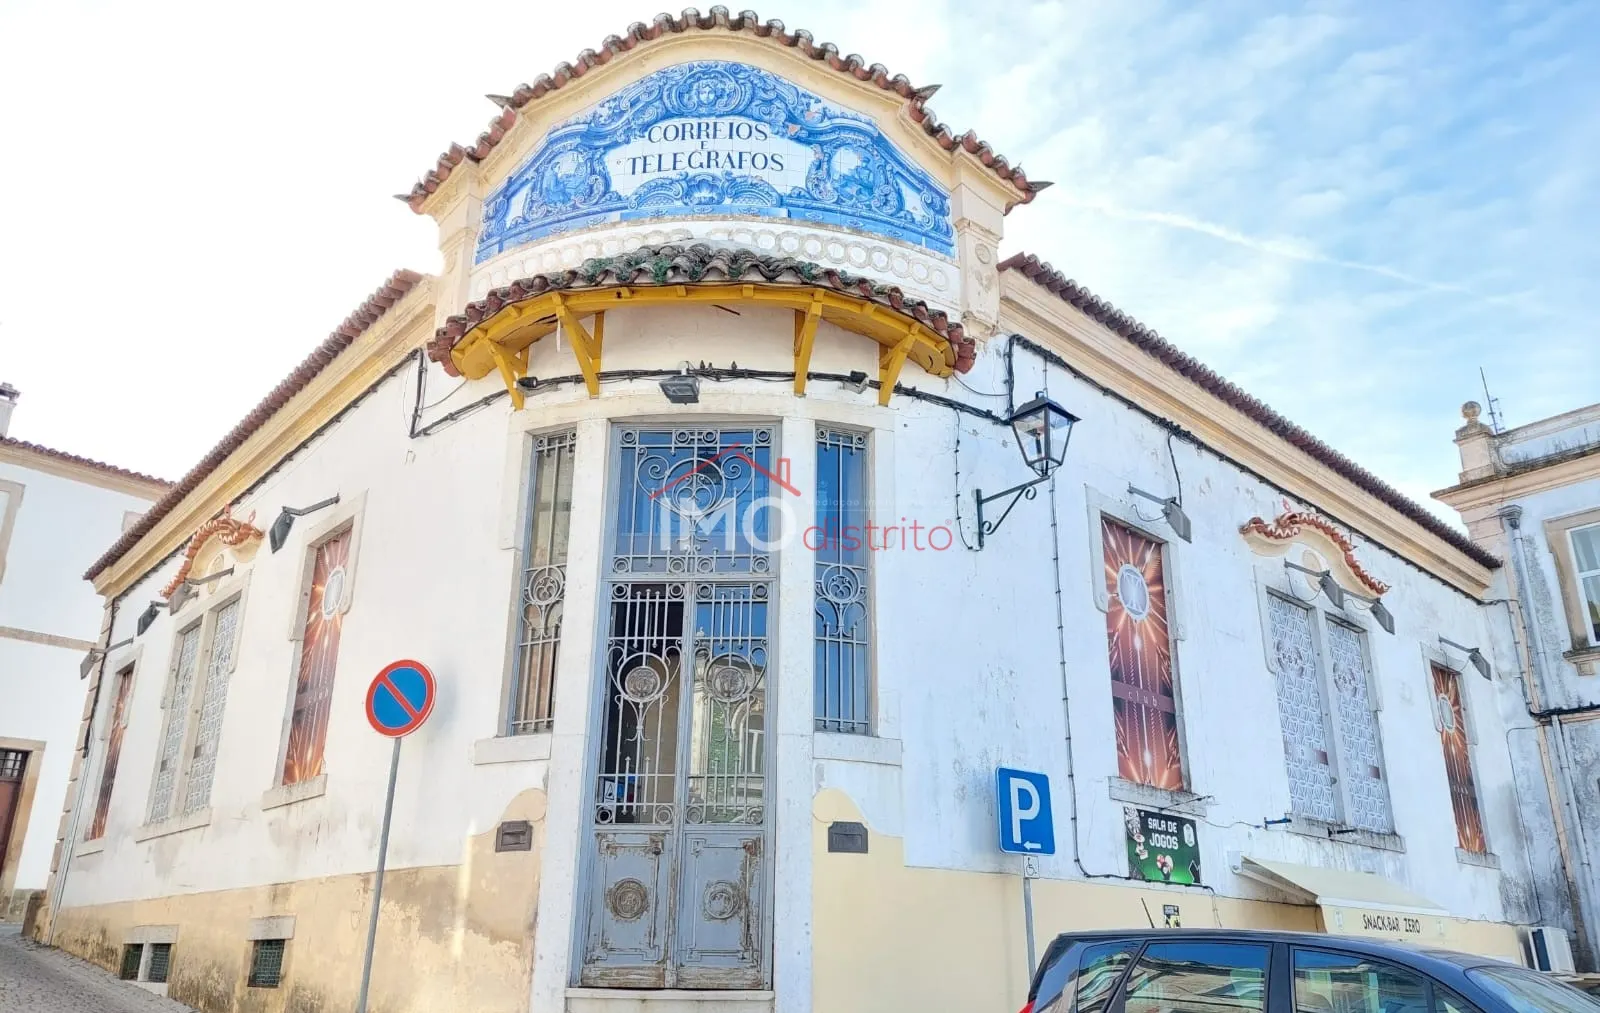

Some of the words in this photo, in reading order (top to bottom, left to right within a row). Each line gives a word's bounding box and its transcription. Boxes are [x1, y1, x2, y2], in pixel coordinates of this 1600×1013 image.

[648, 121, 768, 144] CORREIOS
[700, 140, 709, 150] E
[627, 150, 785, 176] TELEGRAFOS
[1128, 690, 1158, 707] club
[1009, 777, 1041, 844] P
[1147, 817, 1166, 831] SALA
[1167, 821, 1178, 833] DE
[1149, 832, 1179, 850] JOGOS
[1404, 917, 1421, 934] ZERO
